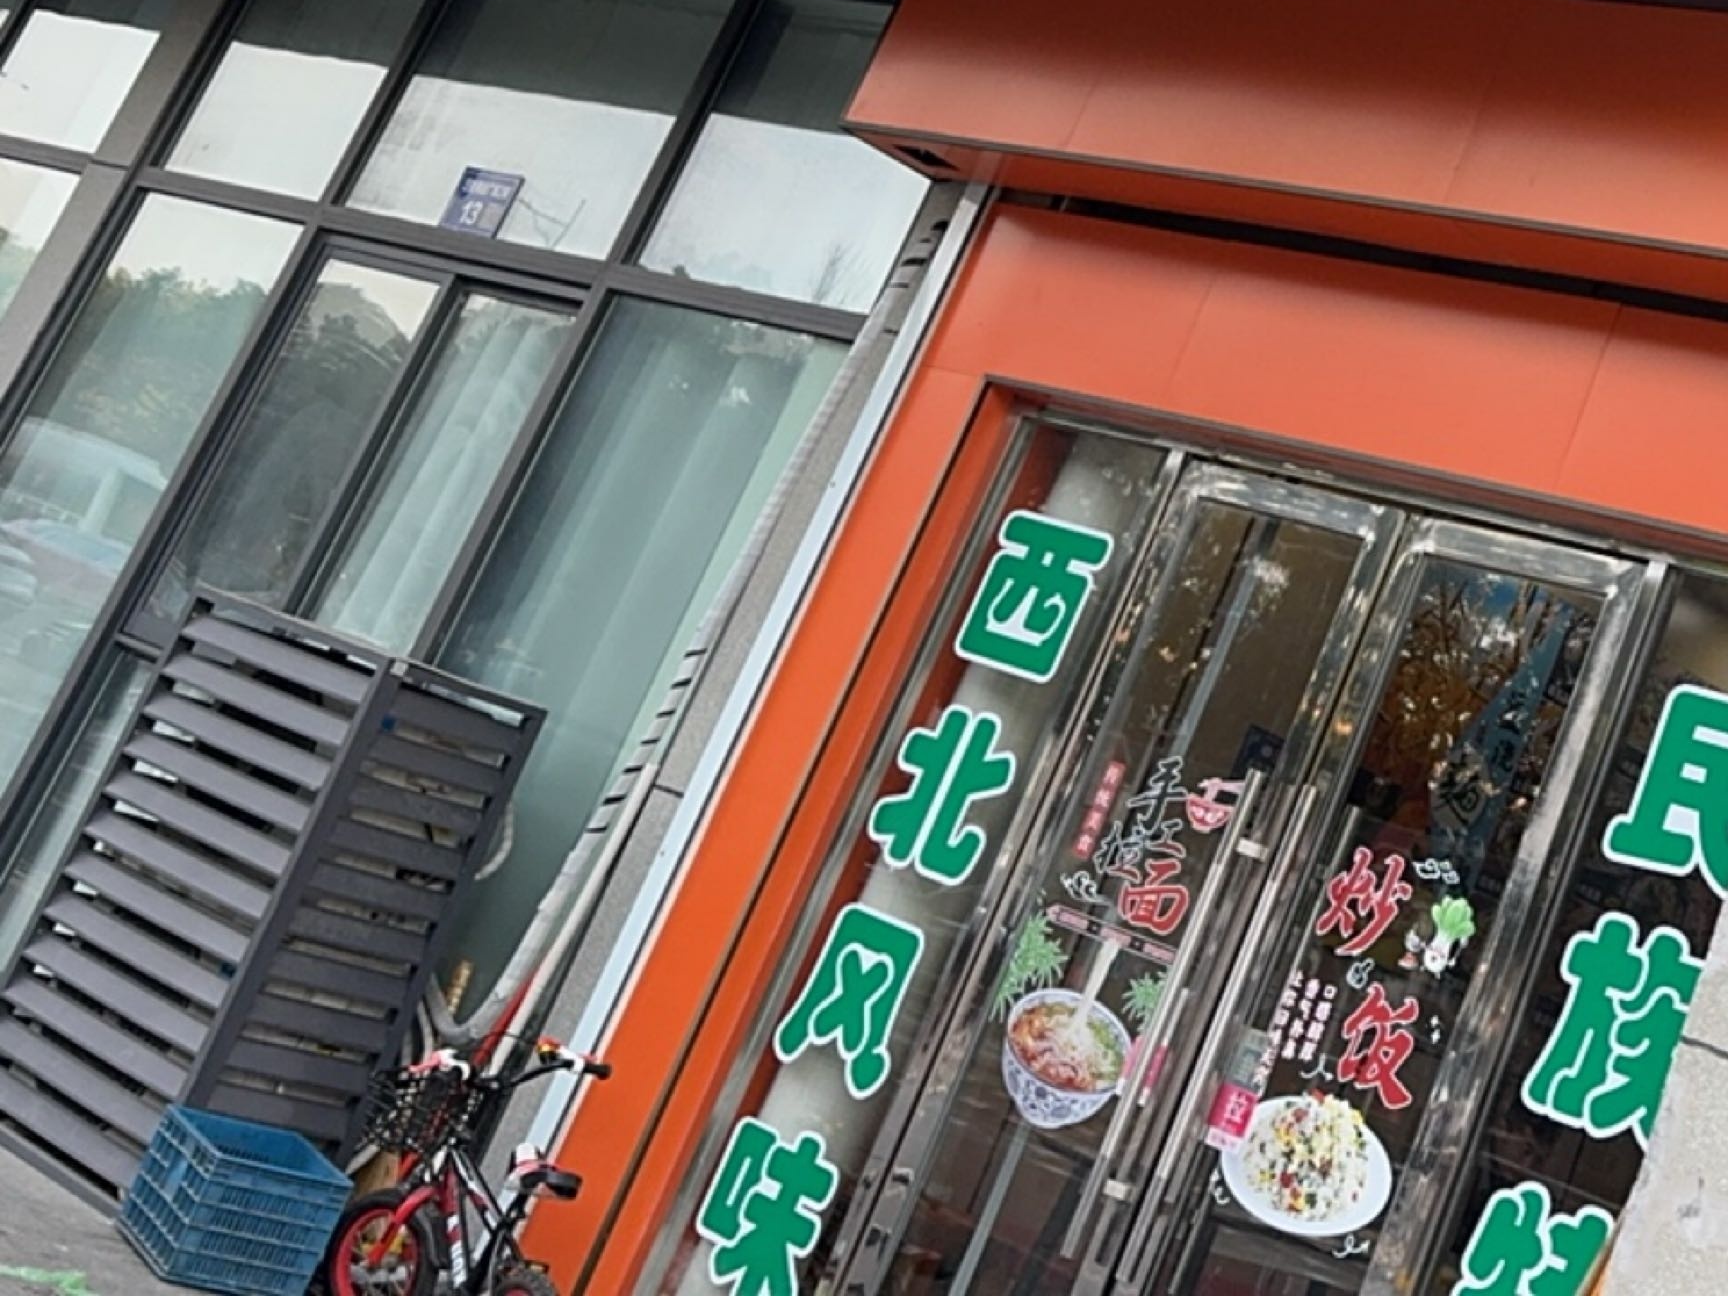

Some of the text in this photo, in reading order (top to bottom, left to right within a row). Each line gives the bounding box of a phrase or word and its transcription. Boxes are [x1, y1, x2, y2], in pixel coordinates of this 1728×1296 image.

[697, 510, 1114, 1296] 西北风味
[1315, 847, 1419, 1109] 炒饭
